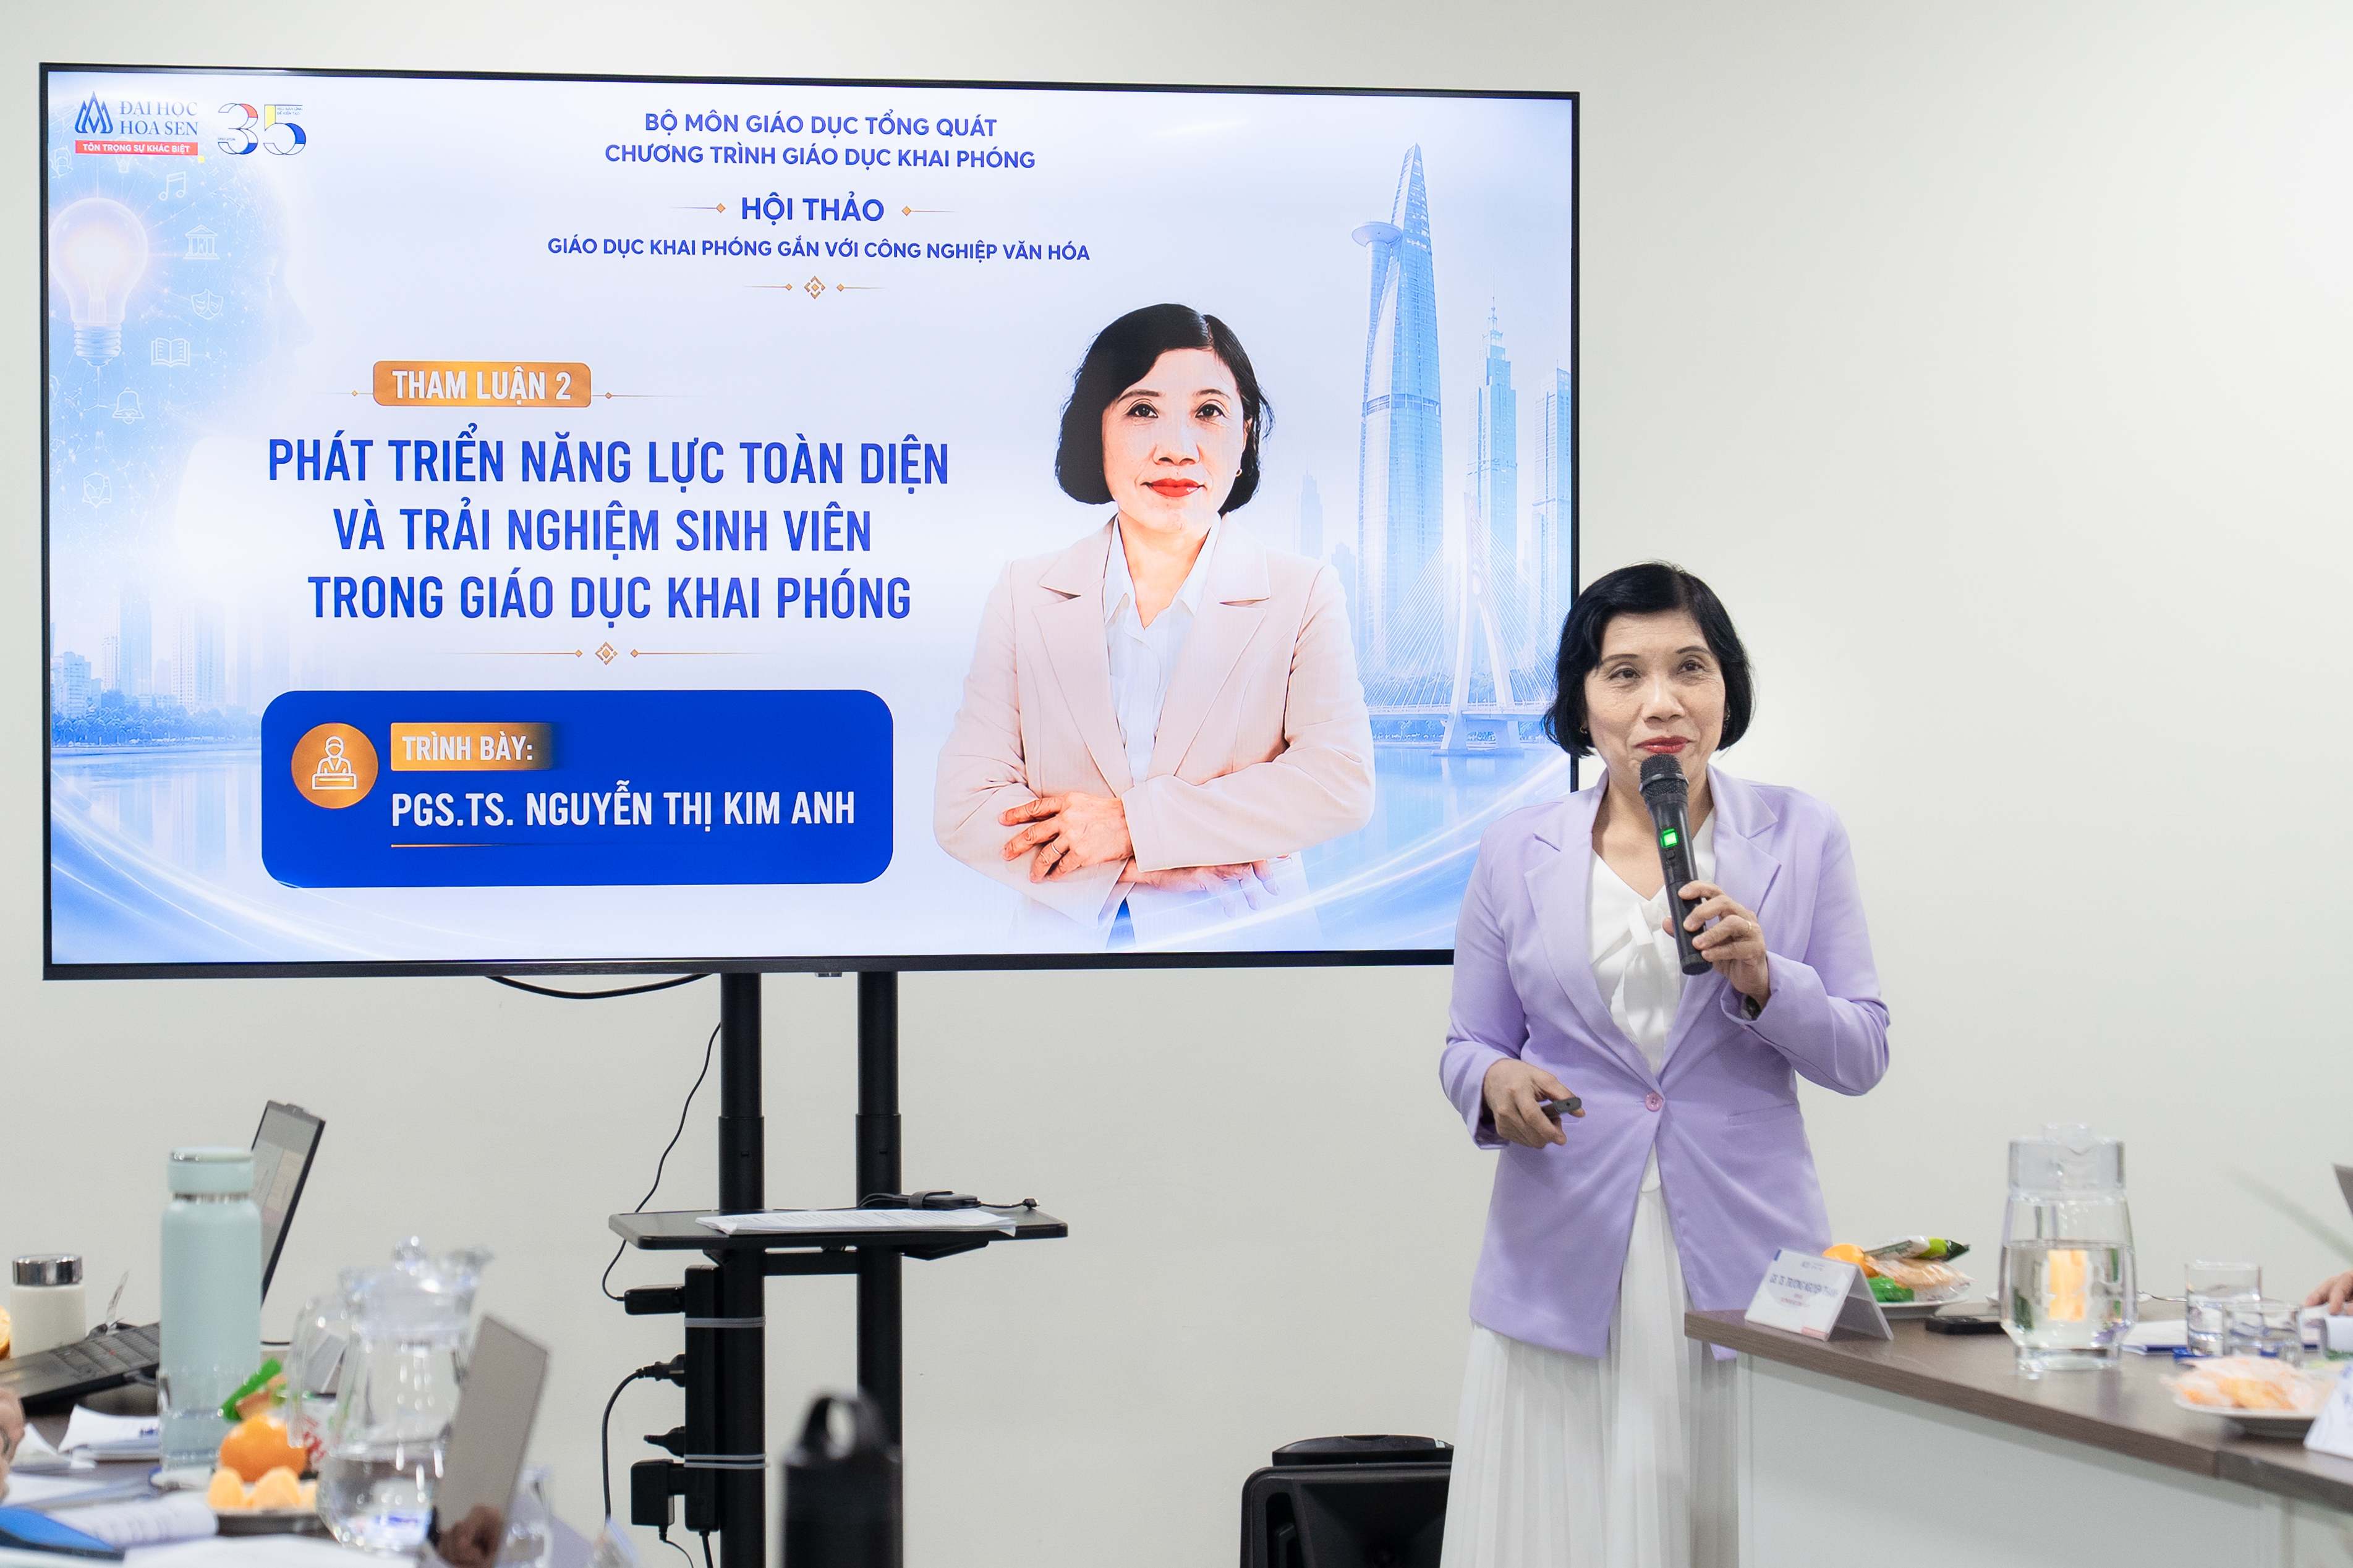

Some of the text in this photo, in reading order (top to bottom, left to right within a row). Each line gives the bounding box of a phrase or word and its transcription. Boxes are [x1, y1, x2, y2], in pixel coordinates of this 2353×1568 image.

[119, 101, 197, 117] ĐẠI HỌC
[646, 109, 997, 138] BỘ MÔN GIÁO DỤC TỔNG QUÁT
[119, 121, 198, 135] HOA SEN
[218, 103, 307, 155] 35
[83, 142, 190, 155] TÔN TRỌNG SỰ KHÁC BIỆT
[605, 142, 1035, 171] CHƯƠNG TRÌNH GIÁO DỤC KHAI PHÓNG
[742, 191, 884, 226] HỘI THẢO
[548, 235, 1089, 263] GIÁO DỤC KHAI PHÓNG GẮN VỚI CÔNG NGHIỆP VĂN HÓA
[392, 365, 572, 405] THAM LUẬN 2
[270, 423, 947, 494] PHÁT TRIỂN NĂNG LỰC TOÀN DIỆN
[333, 496, 870, 560] VÀ TRẢI NGHIỆM SINH VIÊN
[308, 567, 910, 629] TRONG GIÁO DỤC KHAI PHÓNG
[402, 731, 533, 760] TRÌNH BÀY:
[393, 779, 854, 831] PGS.TS. NGUYỄN THỊ KIM ANH
